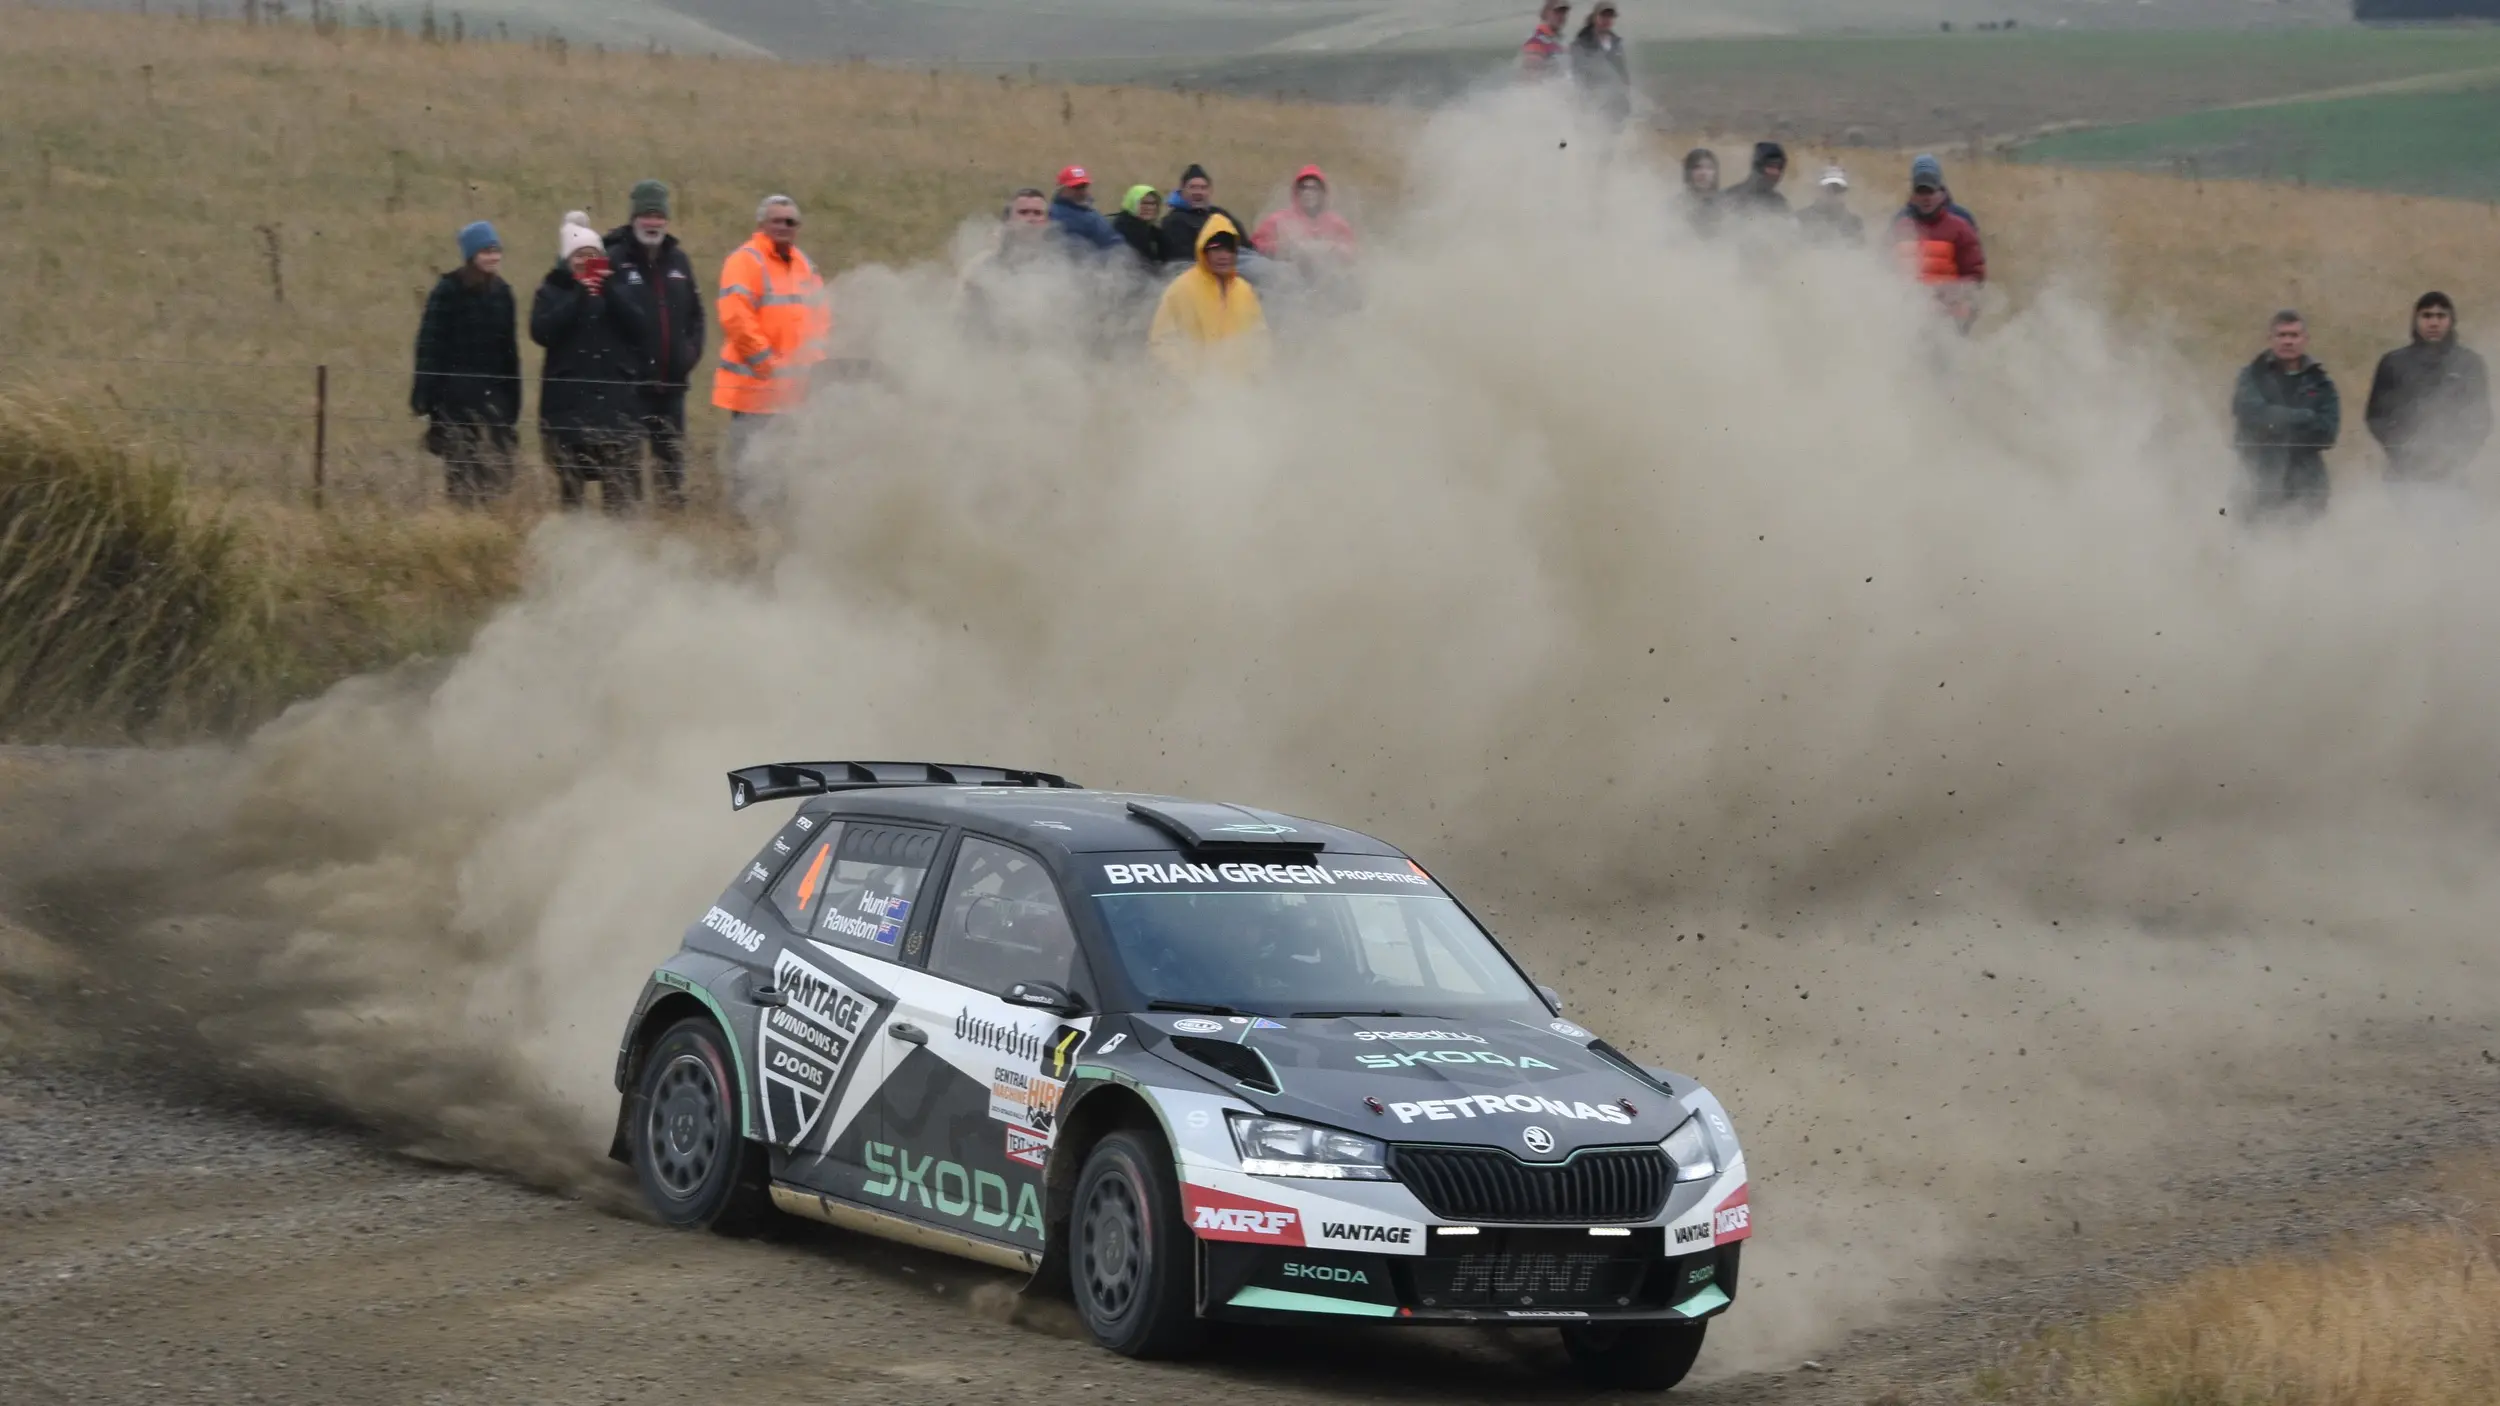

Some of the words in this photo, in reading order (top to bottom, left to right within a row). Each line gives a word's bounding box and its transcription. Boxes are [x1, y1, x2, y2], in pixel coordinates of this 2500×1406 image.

[1103, 863, 1219, 884] BRIAN
[1218, 863, 1336, 884] GREEN
[1332, 869, 1429, 885] PROPERTIES
[858, 890, 889, 916] Hunt
[702, 905, 765, 952] PETRONAS
[780, 960, 864, 1034] VANTAGE
[772, 1009, 832, 1051] WINDOWS
[831, 1042, 839, 1057] &
[773, 1051, 823, 1086] DOORS
[994, 1067, 1028, 1089] CENTRAL
[1389, 1094, 1632, 1125] PETRONAS
[1009, 1134, 1026, 1151] TEXT
[1193, 1206, 1296, 1235] MRF
[1321, 1221, 1412, 1244] VANTAGE
[1674, 1222, 1711, 1244] VANTAGE
[1450, 1254, 1609, 1292] HUNT
